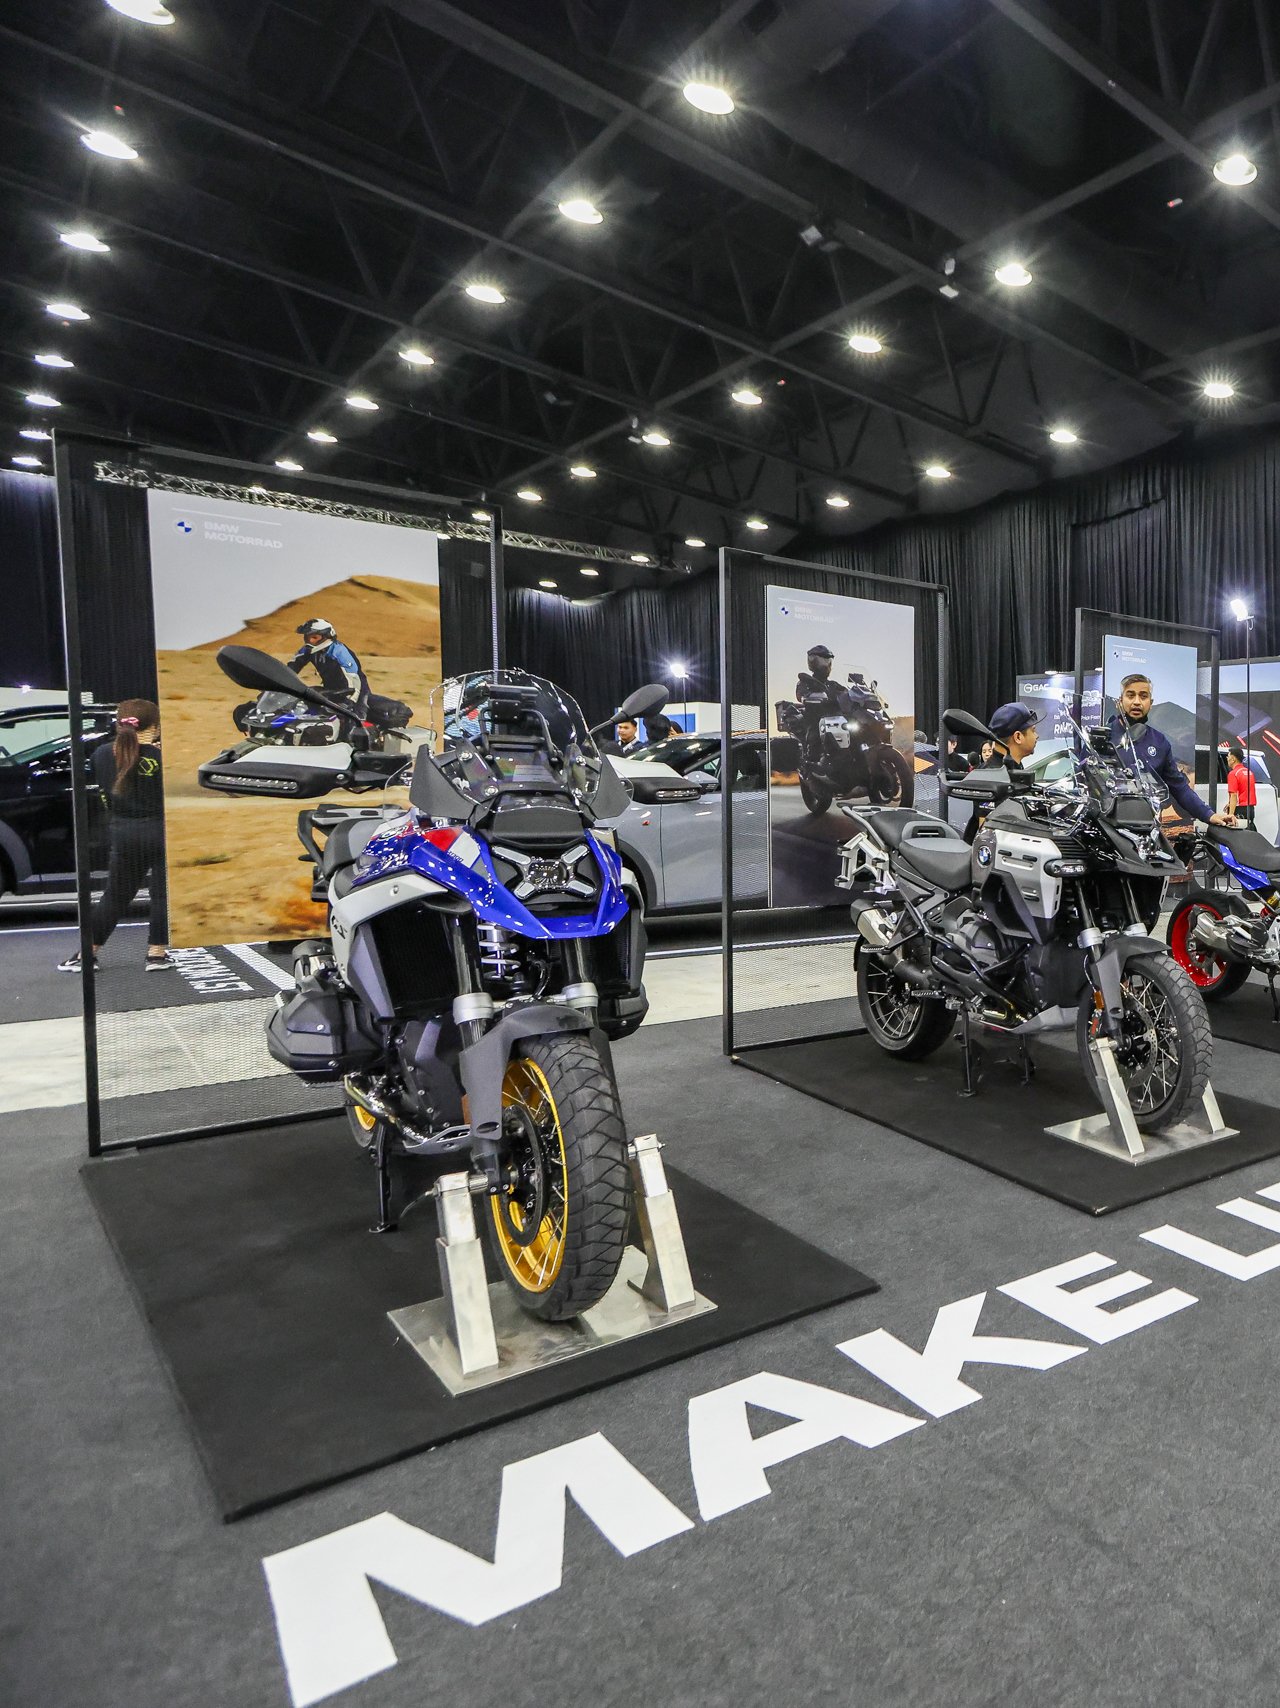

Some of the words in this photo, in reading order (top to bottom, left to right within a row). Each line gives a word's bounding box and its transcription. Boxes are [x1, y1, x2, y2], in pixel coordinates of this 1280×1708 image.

[204, 521, 240, 534] BMW
[204, 532, 283, 549] MOTORRAD
[262, 1251, 1199, 1708] MAKE
